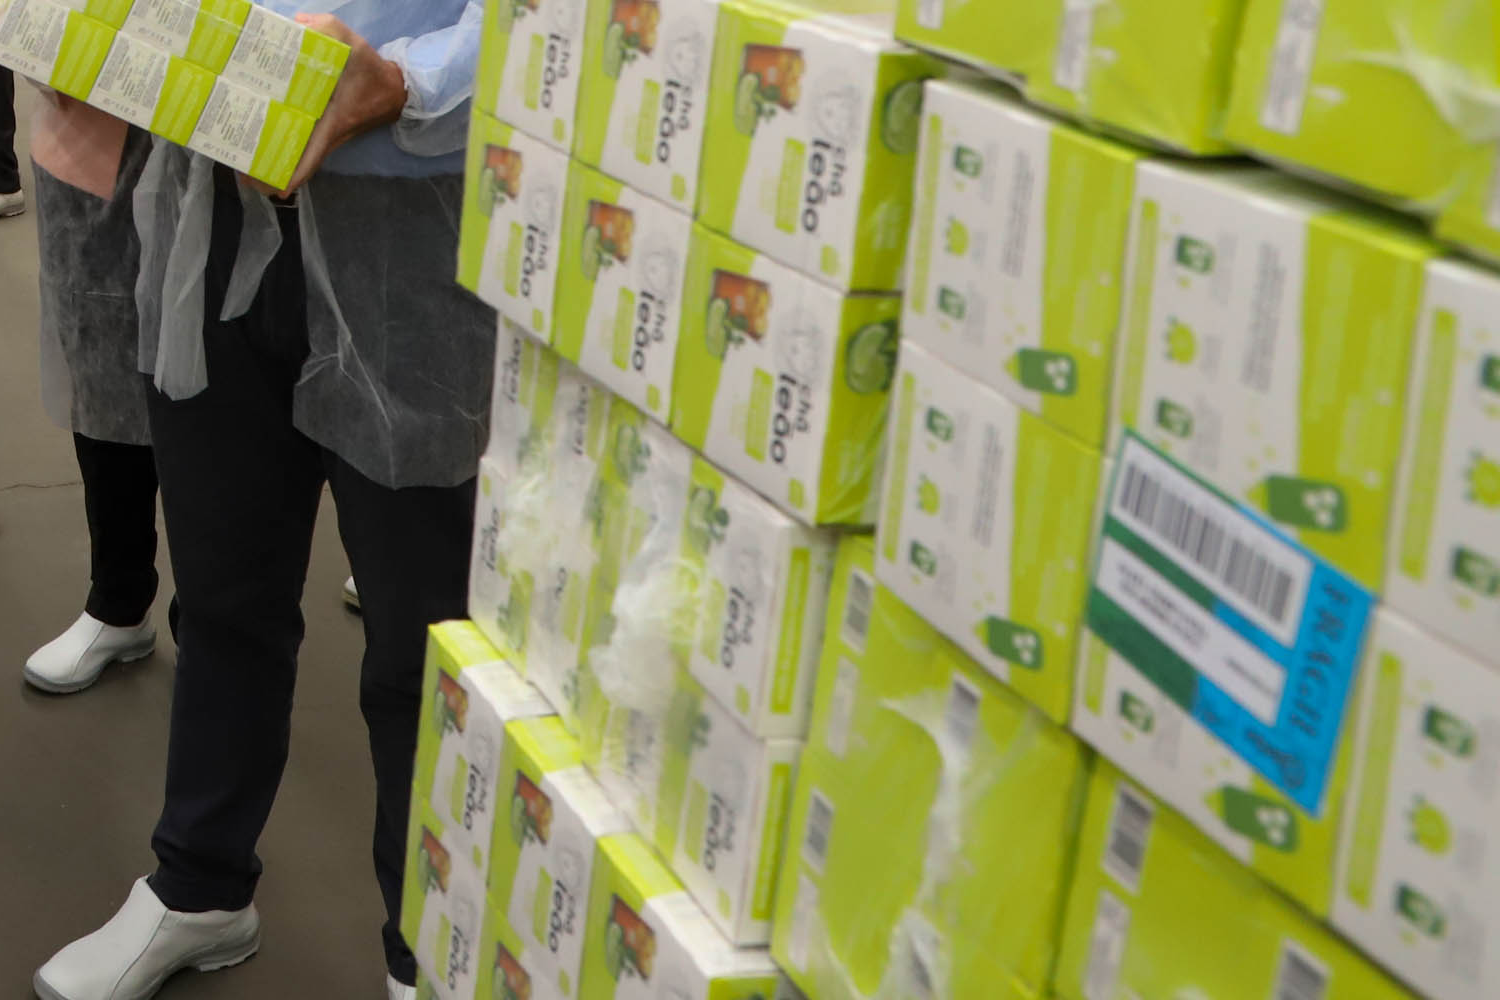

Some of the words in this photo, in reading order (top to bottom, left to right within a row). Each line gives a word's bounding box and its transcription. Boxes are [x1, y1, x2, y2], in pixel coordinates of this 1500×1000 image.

[542, 32, 561, 109] leão
[656, 79, 681, 163] leão
[801, 137, 831, 234] leão
[631, 290, 655, 371] leão
[770, 372, 797, 465] leão
